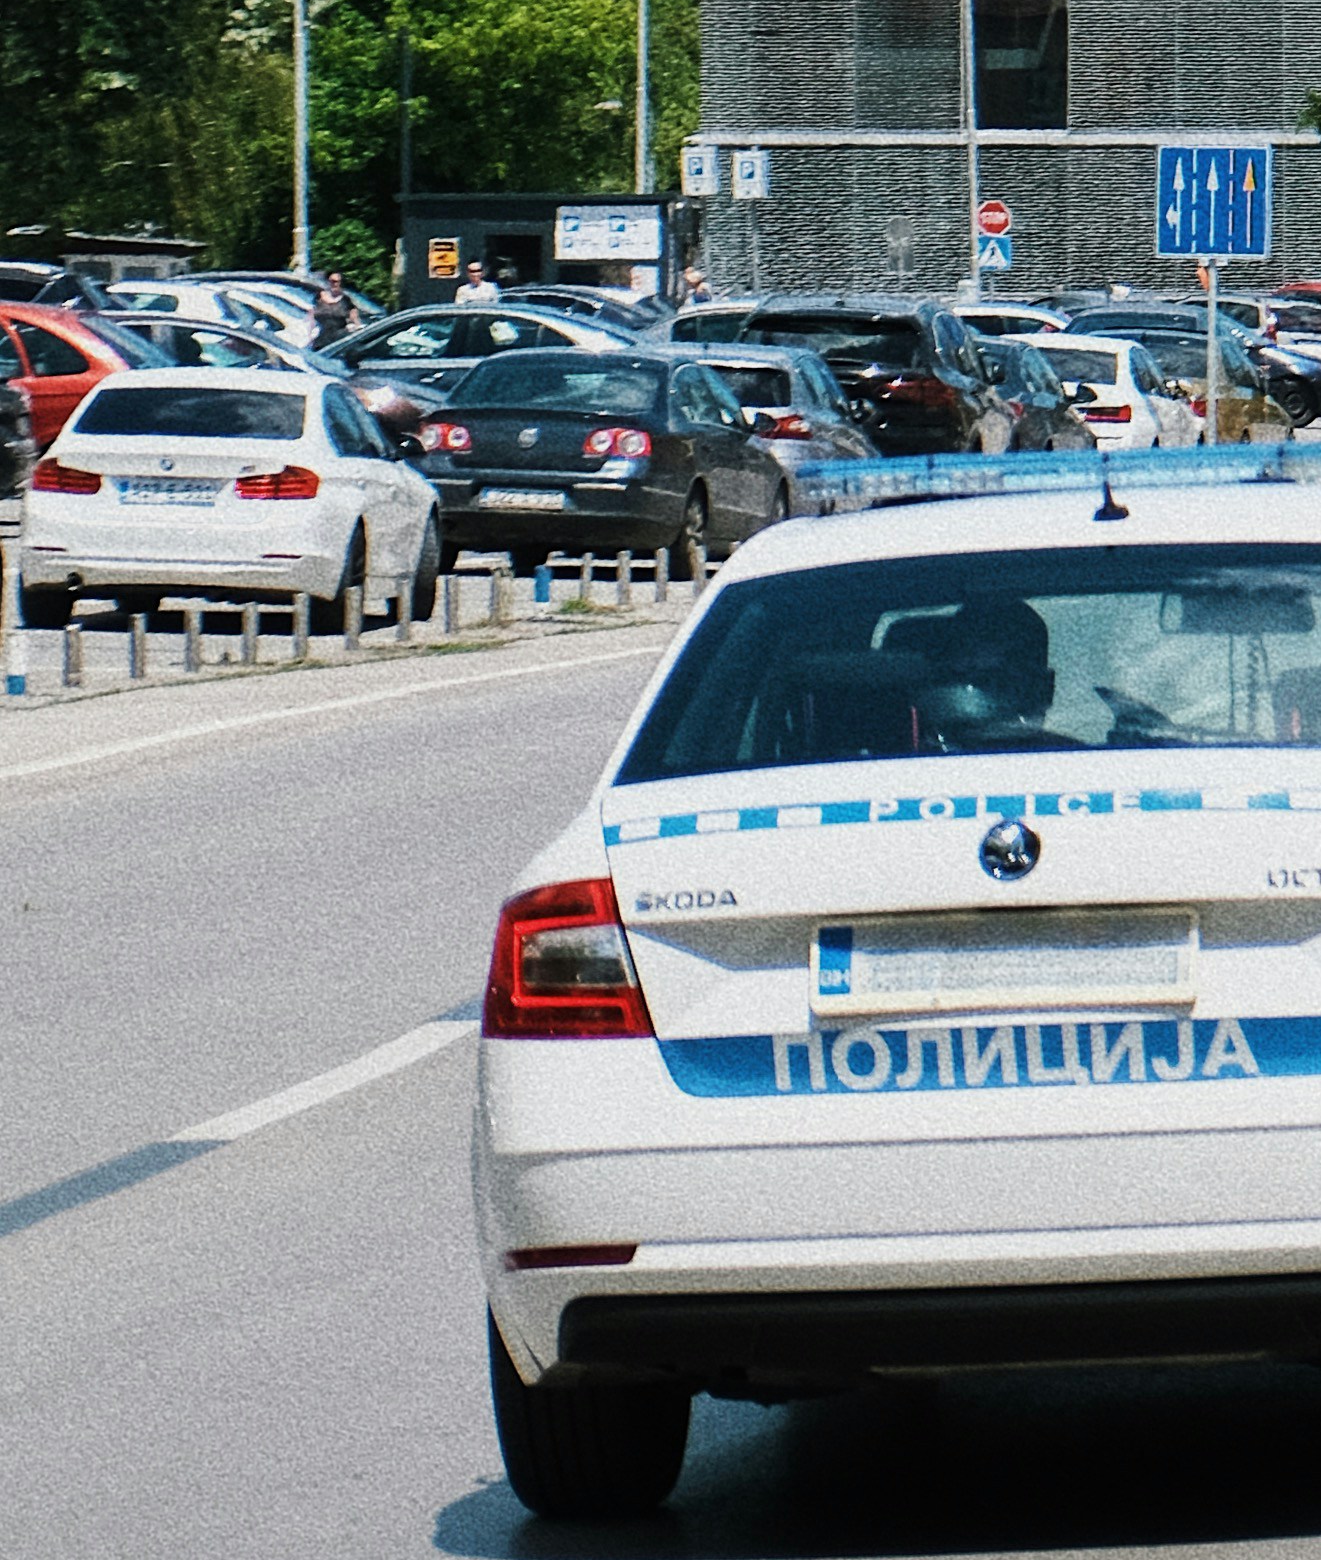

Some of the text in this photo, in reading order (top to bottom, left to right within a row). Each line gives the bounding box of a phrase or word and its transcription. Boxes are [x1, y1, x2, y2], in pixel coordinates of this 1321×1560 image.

[869, 791, 1142, 822] POLICE
[635, 889, 738, 912] ŠKODA
[771, 1018, 1260, 1092] ПОЛИЦИЈА
